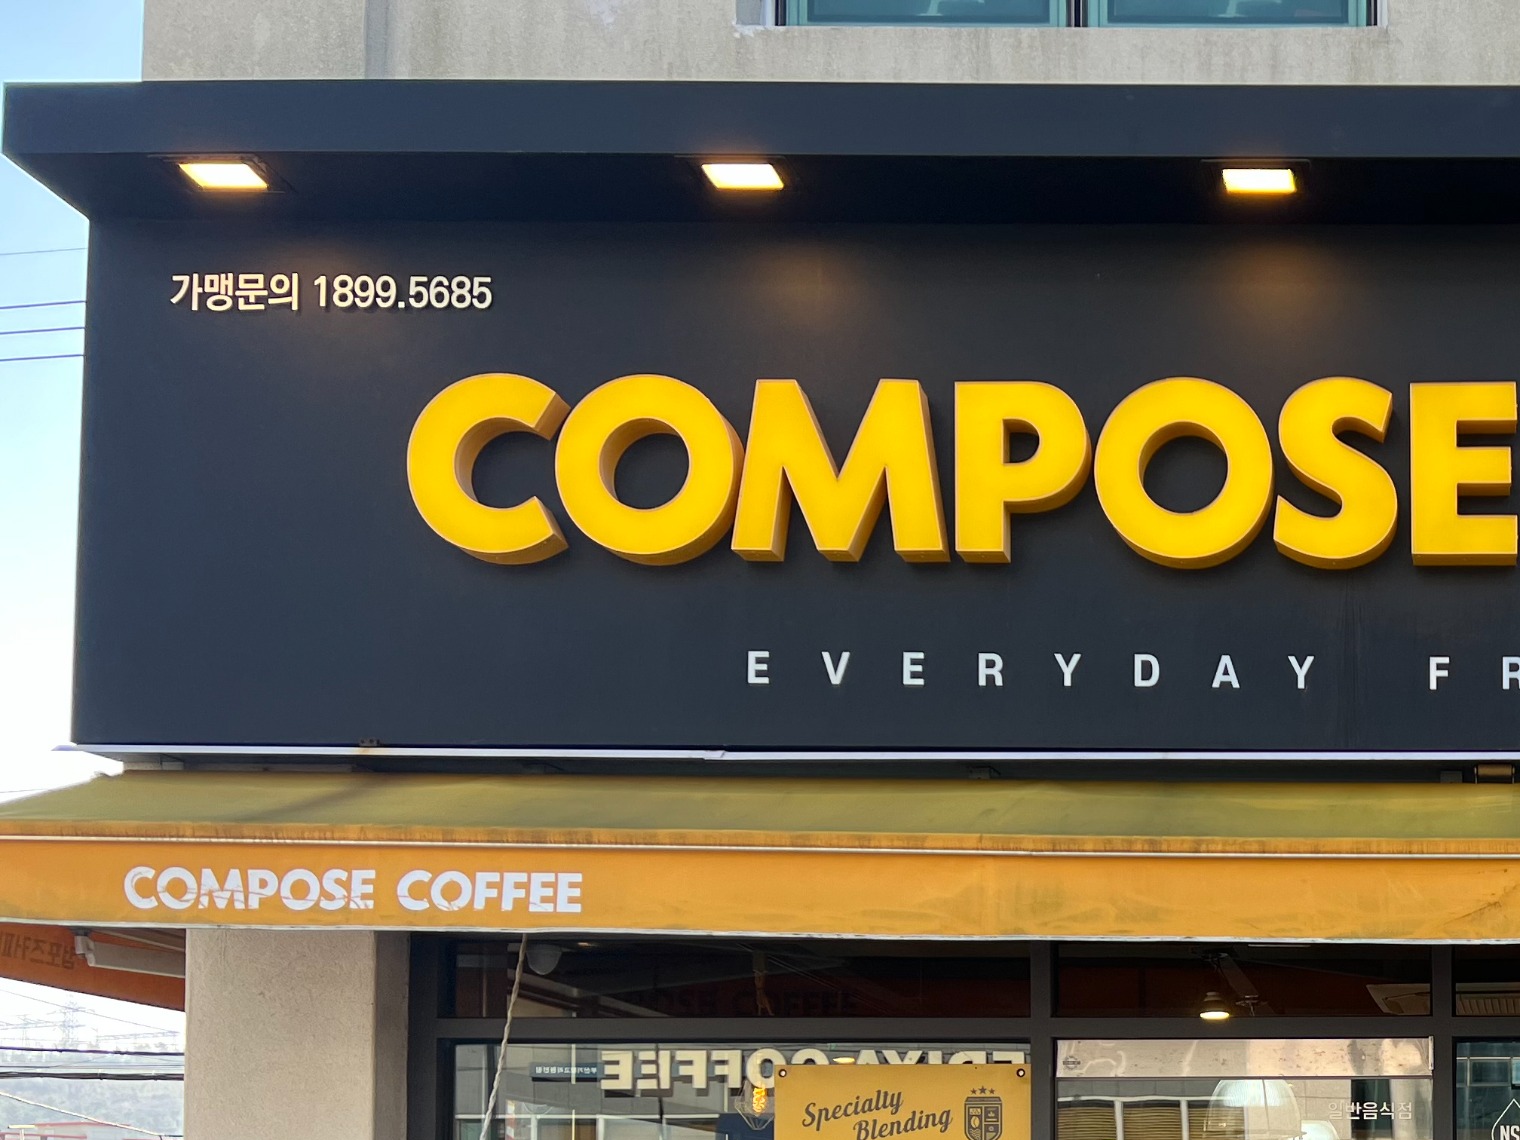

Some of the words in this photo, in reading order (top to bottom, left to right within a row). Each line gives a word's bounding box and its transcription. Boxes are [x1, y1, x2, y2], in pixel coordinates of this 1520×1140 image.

[169, 272, 301, 311] 가맹문의
[313, 275, 494, 311] 1899.5685
[406, 373, 1518, 566] COMPOSE
[746, 650, 1318, 692] EVERYDAY
[123, 866, 376, 911] COMPOSE
[397, 868, 583, 914] COFFEE
[802, 1089, 904, 1131] Specialty
[1328, 1101, 1413, 1120] 일반음식점
